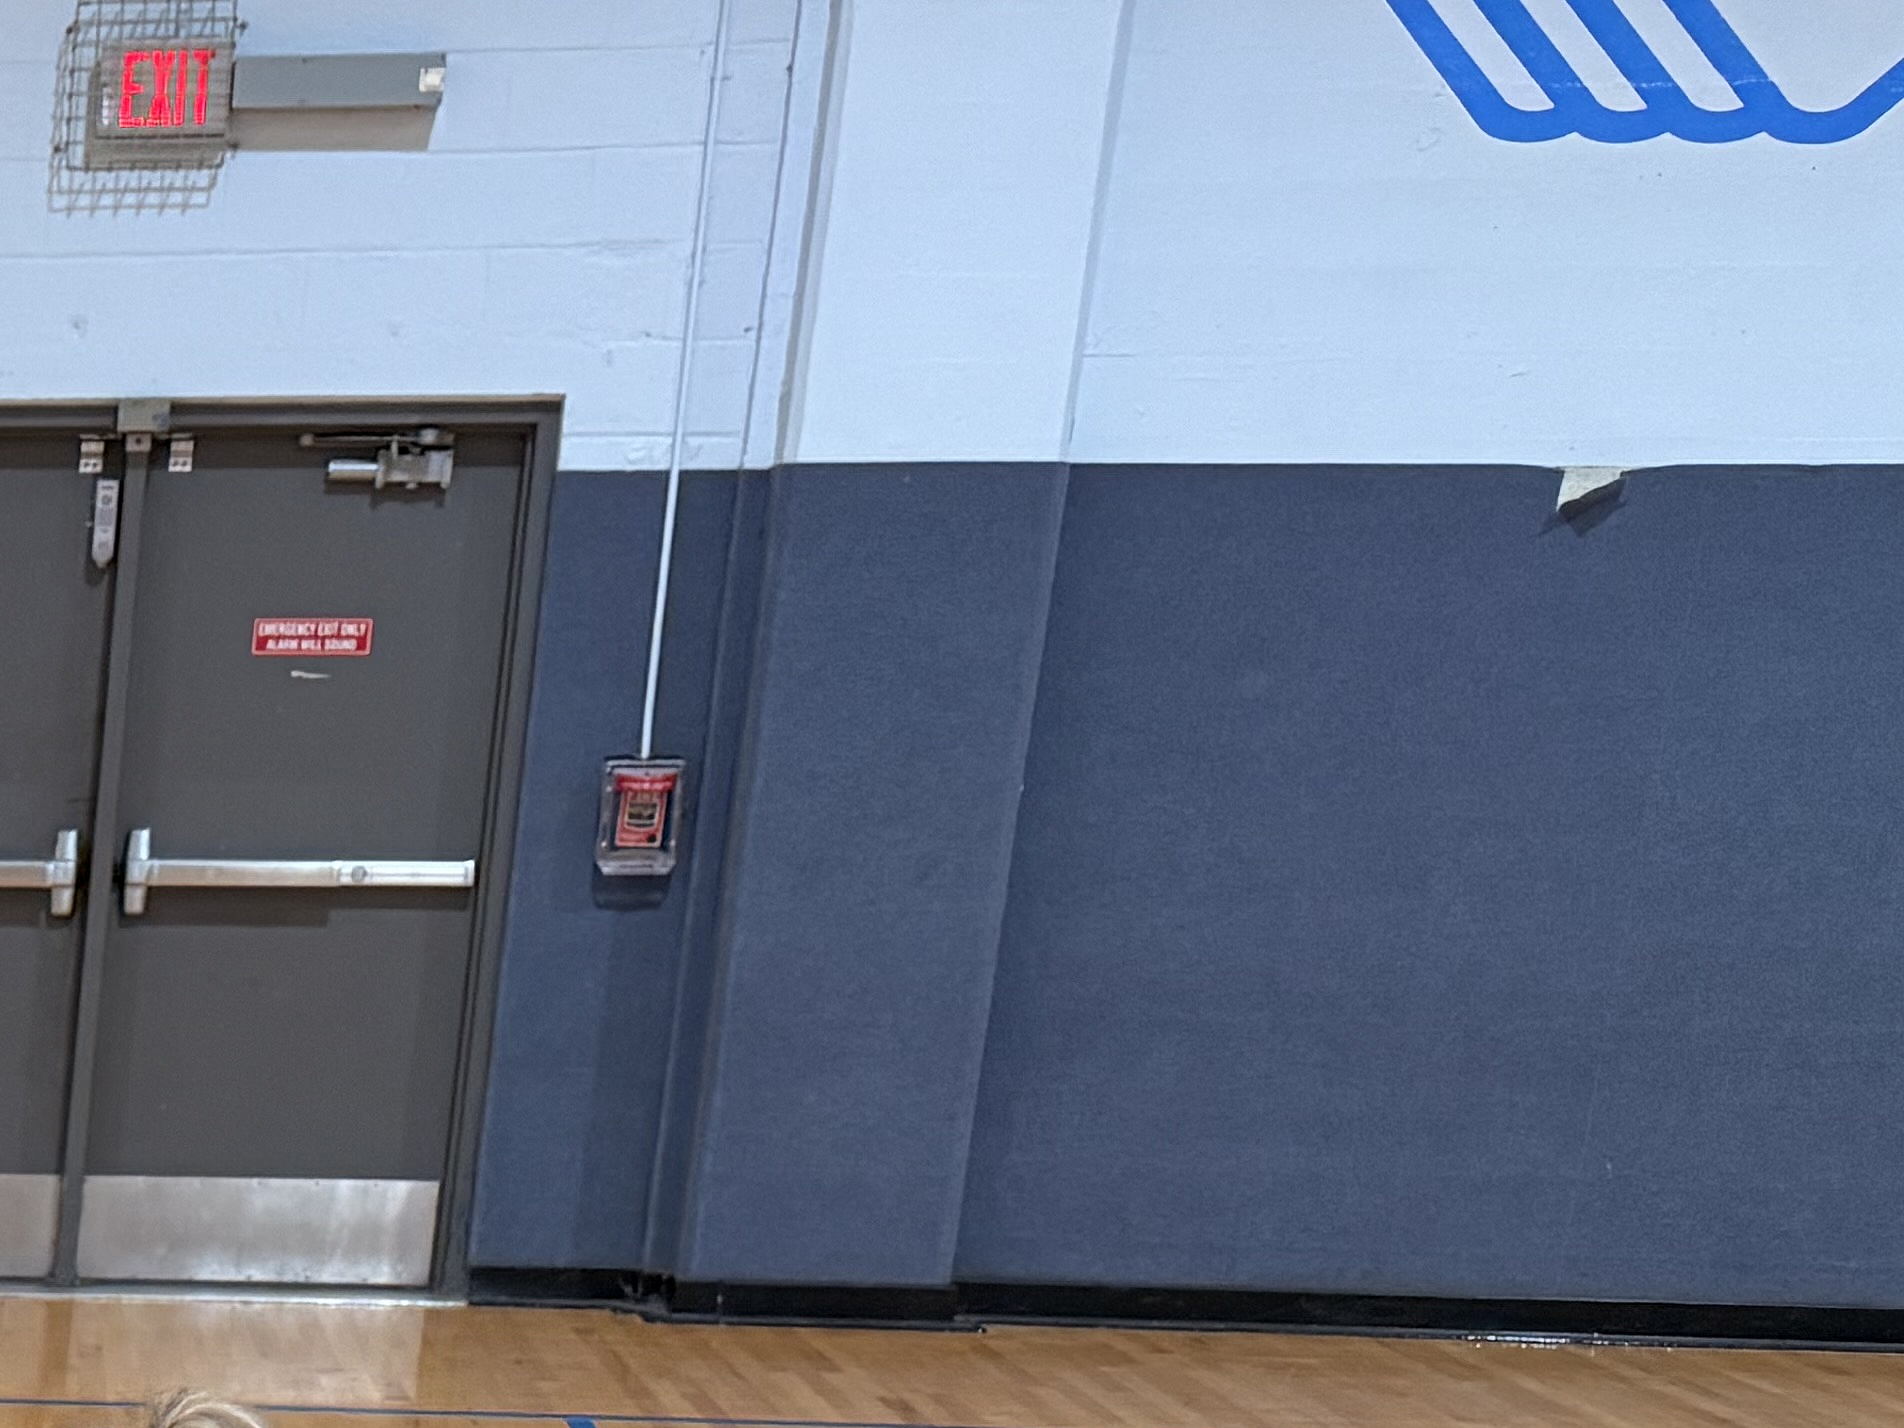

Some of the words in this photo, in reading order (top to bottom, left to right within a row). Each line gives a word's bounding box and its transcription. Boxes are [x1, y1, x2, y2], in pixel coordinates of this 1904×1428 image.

[118, 48, 216, 128] EXIT
[258, 622, 316, 637] EMERGENCY
[317, 621, 339, 637] EXIT
[340, 622, 367, 637] ONLY
[265, 638, 300, 650] ALARM
[300, 639, 322, 650] WILL
[324, 638, 358, 650] SOUND
